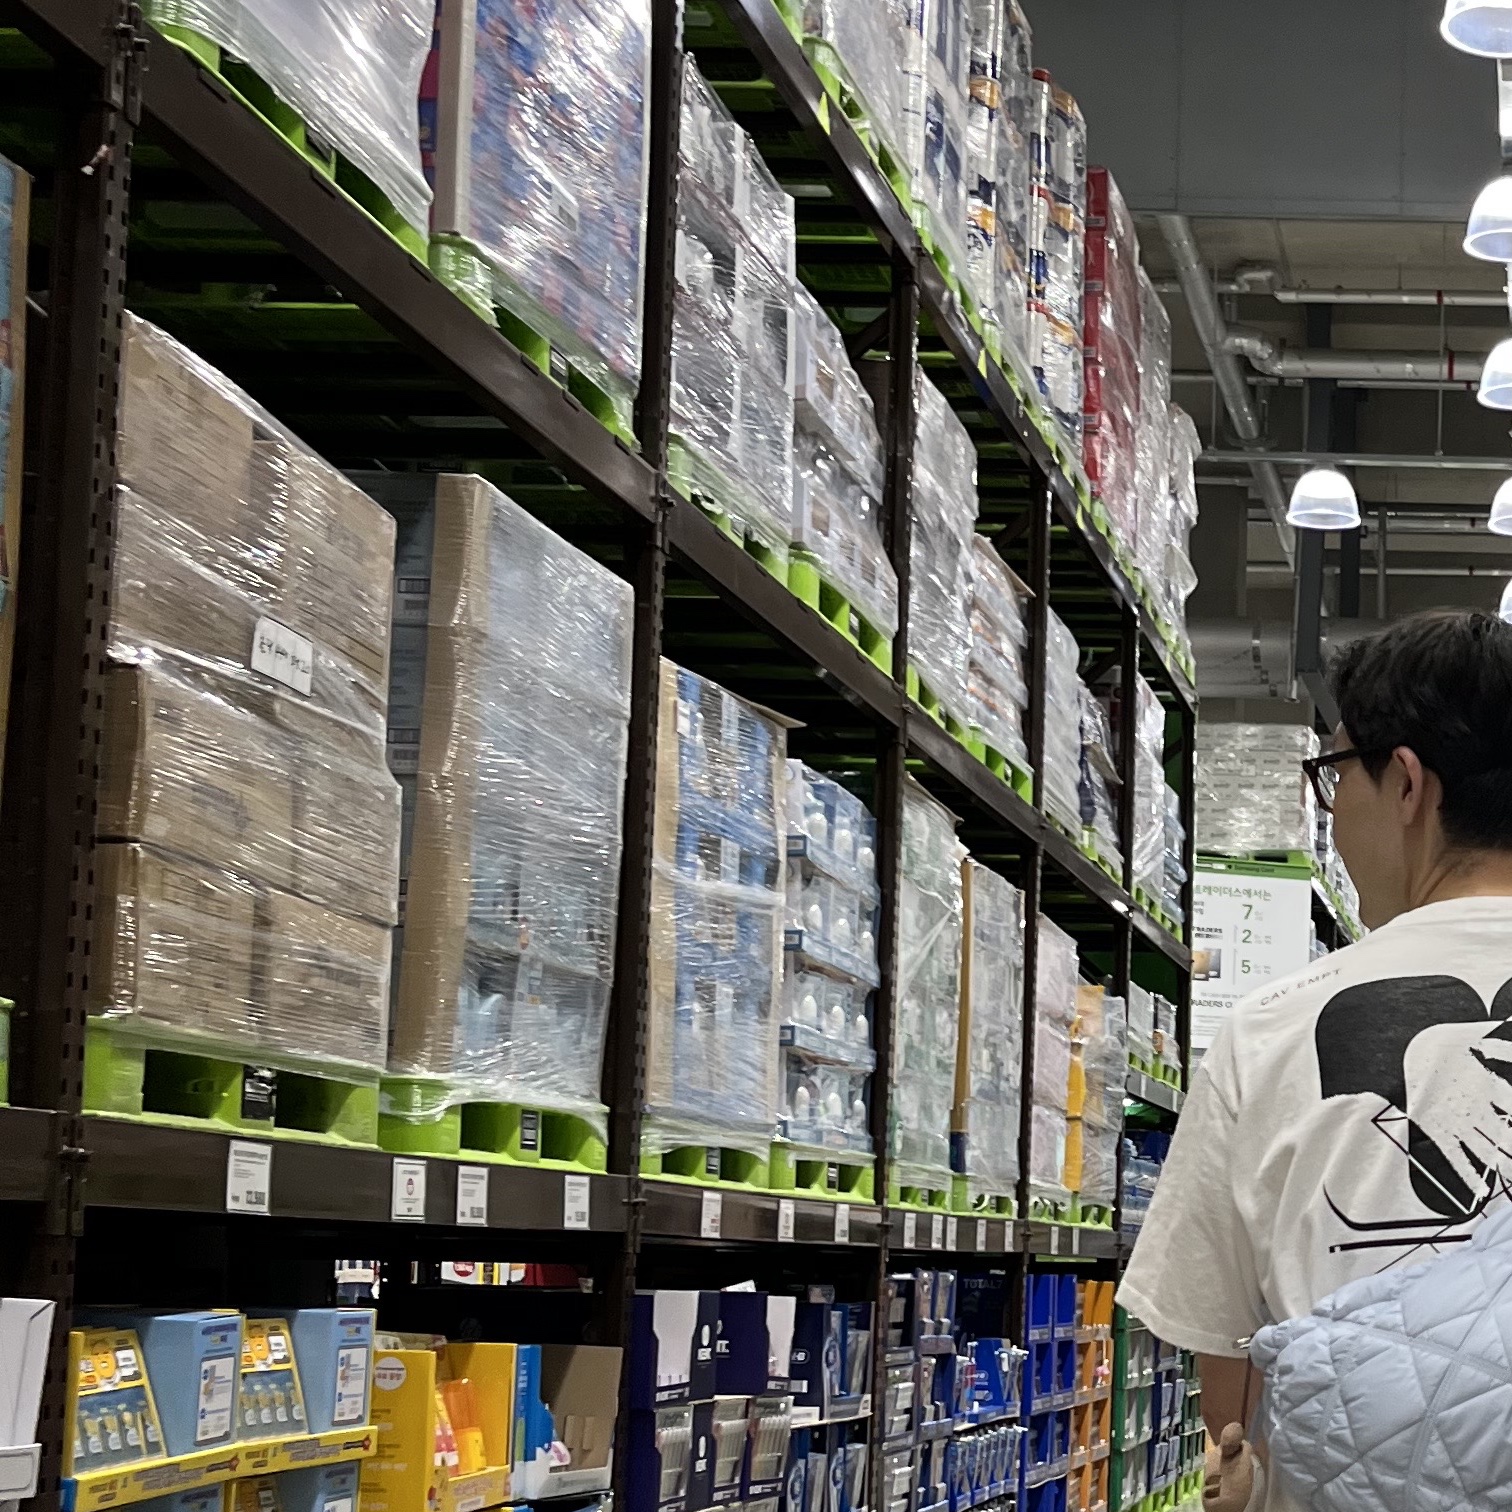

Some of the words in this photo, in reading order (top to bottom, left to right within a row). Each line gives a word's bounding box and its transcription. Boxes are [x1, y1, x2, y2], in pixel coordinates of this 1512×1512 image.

[1242, 904, 1253, 920] 7
[1242, 929, 1252, 944] 2
[1241, 960, 1251, 974] 5
[1260, 986, 1289, 1006] CAV
